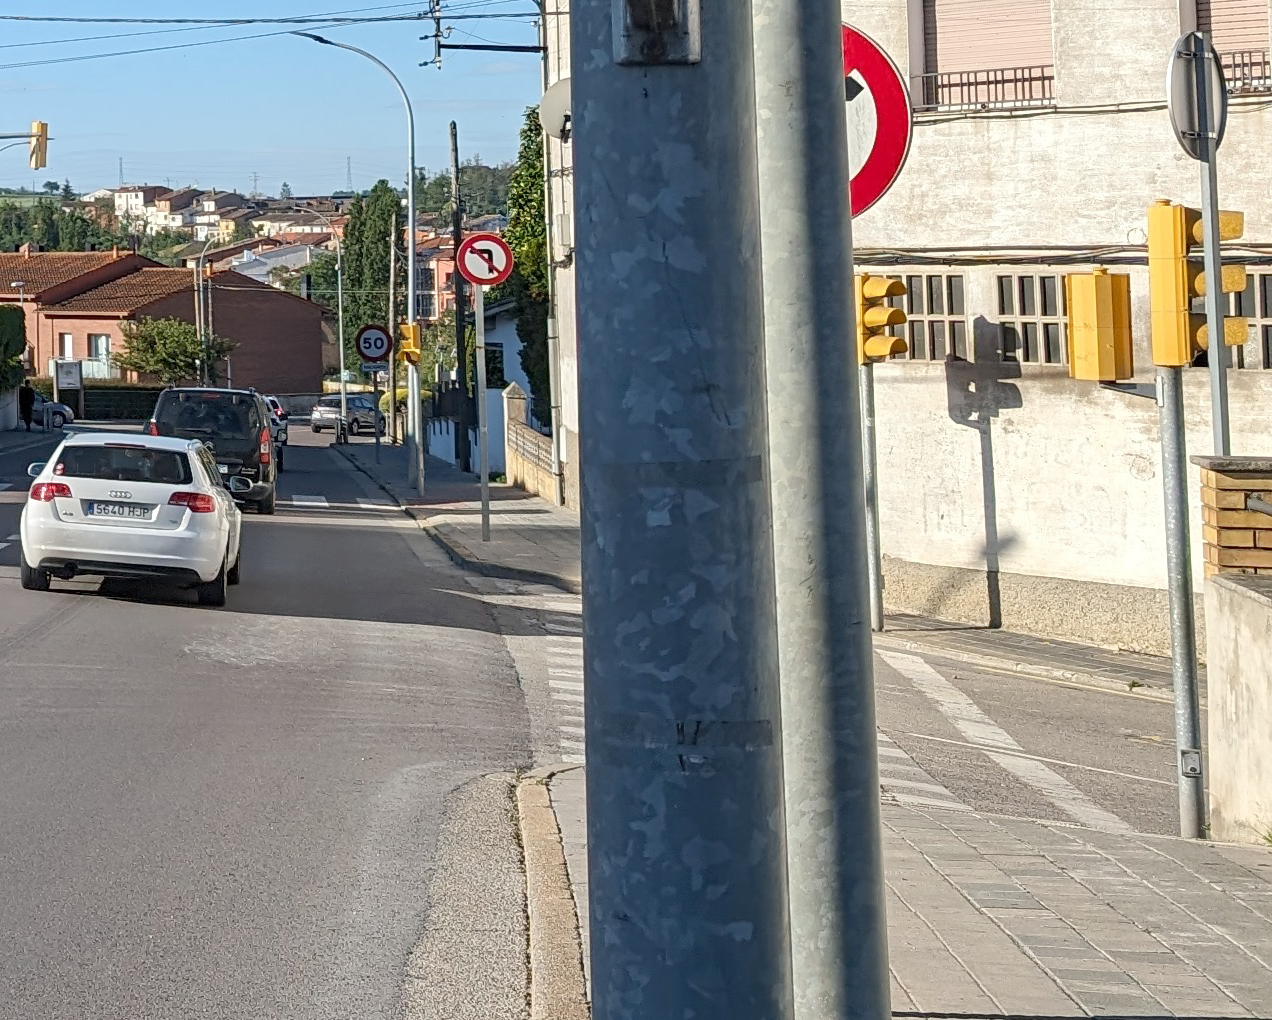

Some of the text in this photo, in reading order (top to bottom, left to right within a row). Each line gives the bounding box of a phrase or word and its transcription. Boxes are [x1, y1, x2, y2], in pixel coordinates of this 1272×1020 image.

[363, 337, 384, 350] 50
[96, 503, 149, 518] 5640 HJP
